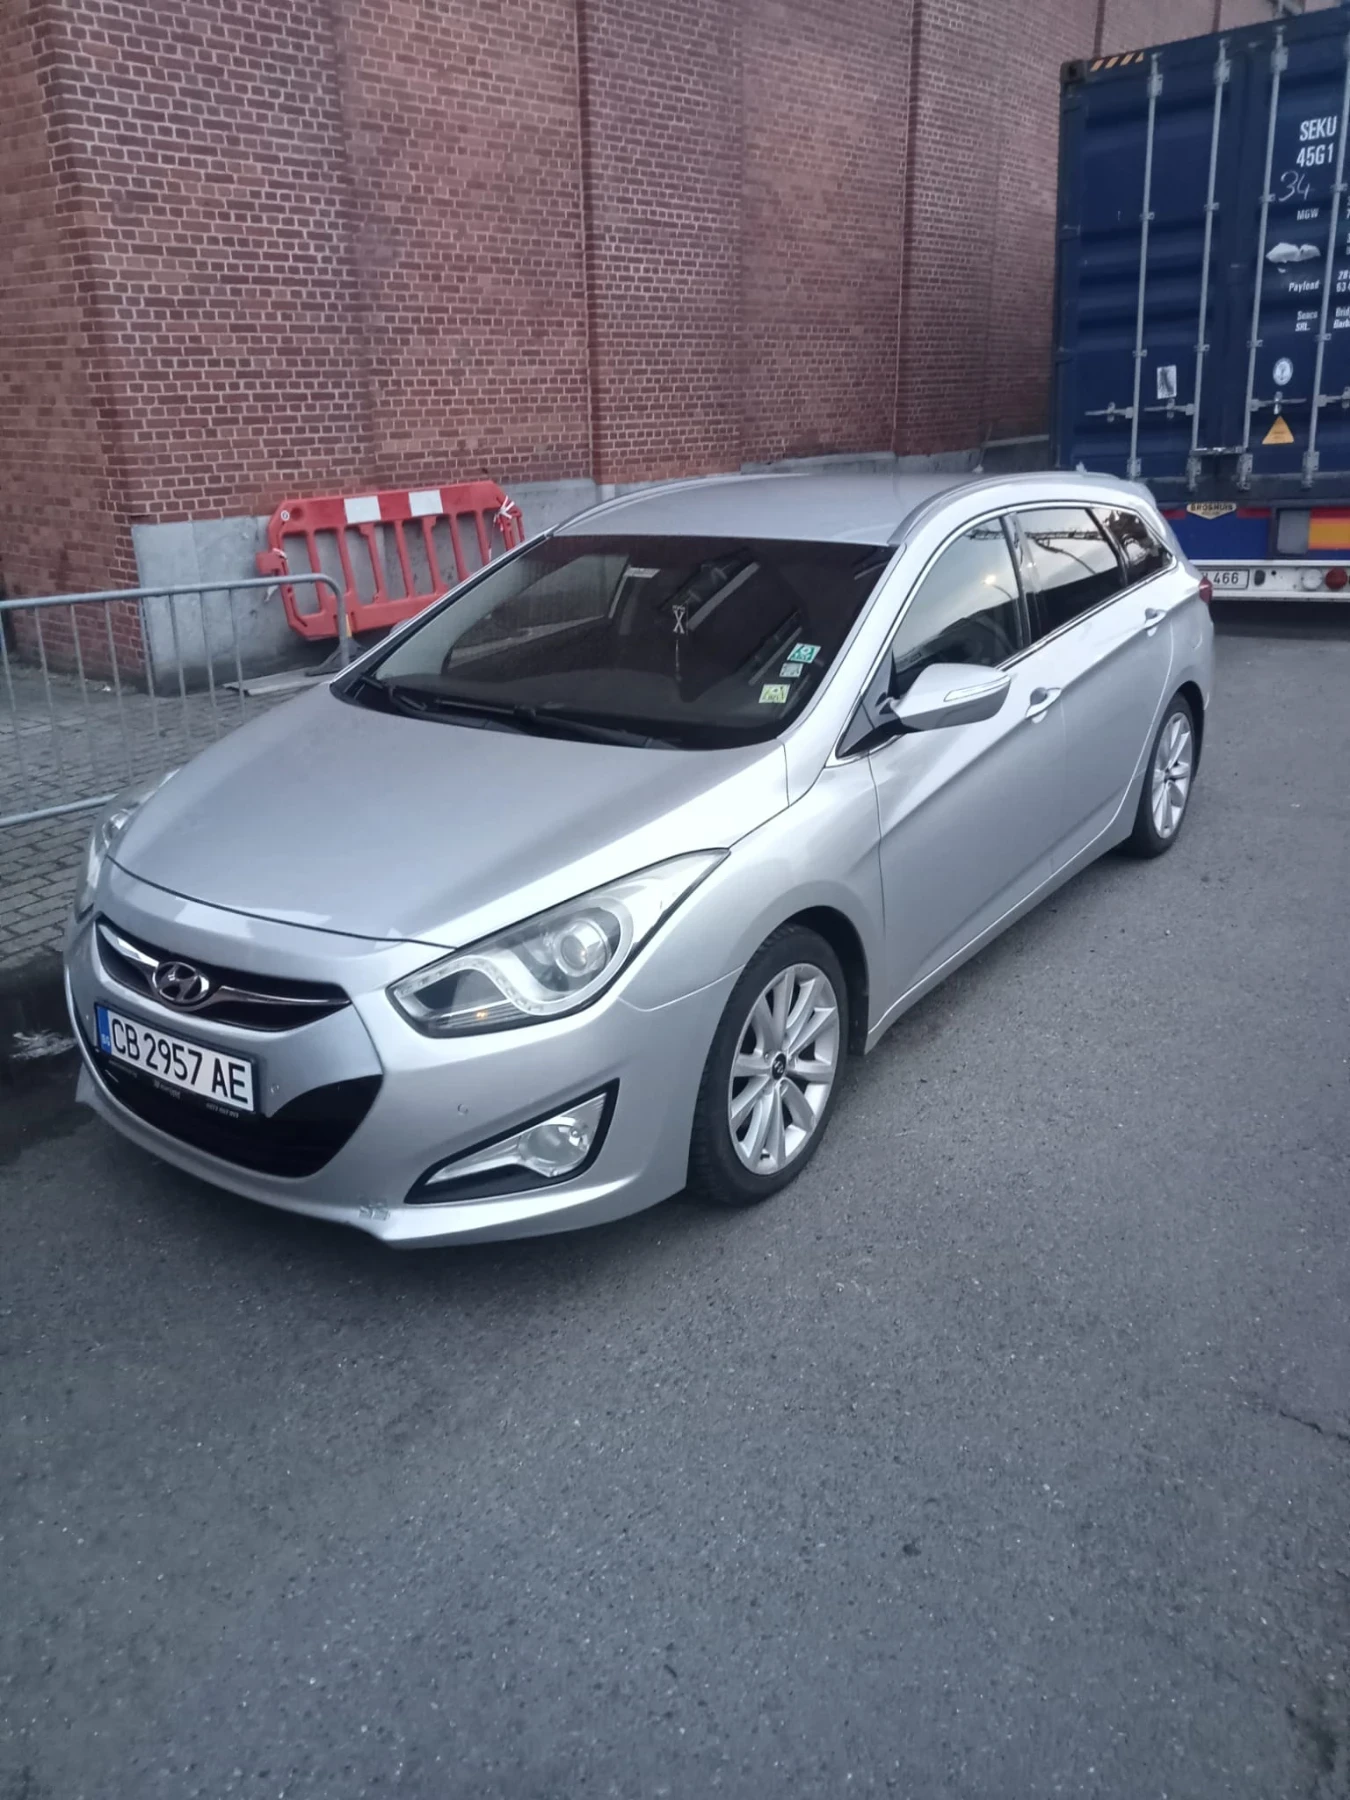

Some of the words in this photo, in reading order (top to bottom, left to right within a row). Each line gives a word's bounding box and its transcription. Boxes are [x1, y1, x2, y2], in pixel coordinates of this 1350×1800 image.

[1300, 115, 1337, 141] SEKU
[1296, 142, 1334, 167] 45G1
[1279, 170, 1314, 202] 34
[1296, 207, 1319, 221] MGW
[1288, 280, 1320, 293] Payload
[1213, 571, 1239, 585] 466
[111, 1018, 141, 1061] CB
[143, 1032, 203, 1086] 2957
[211, 1057, 249, 1105] AE
